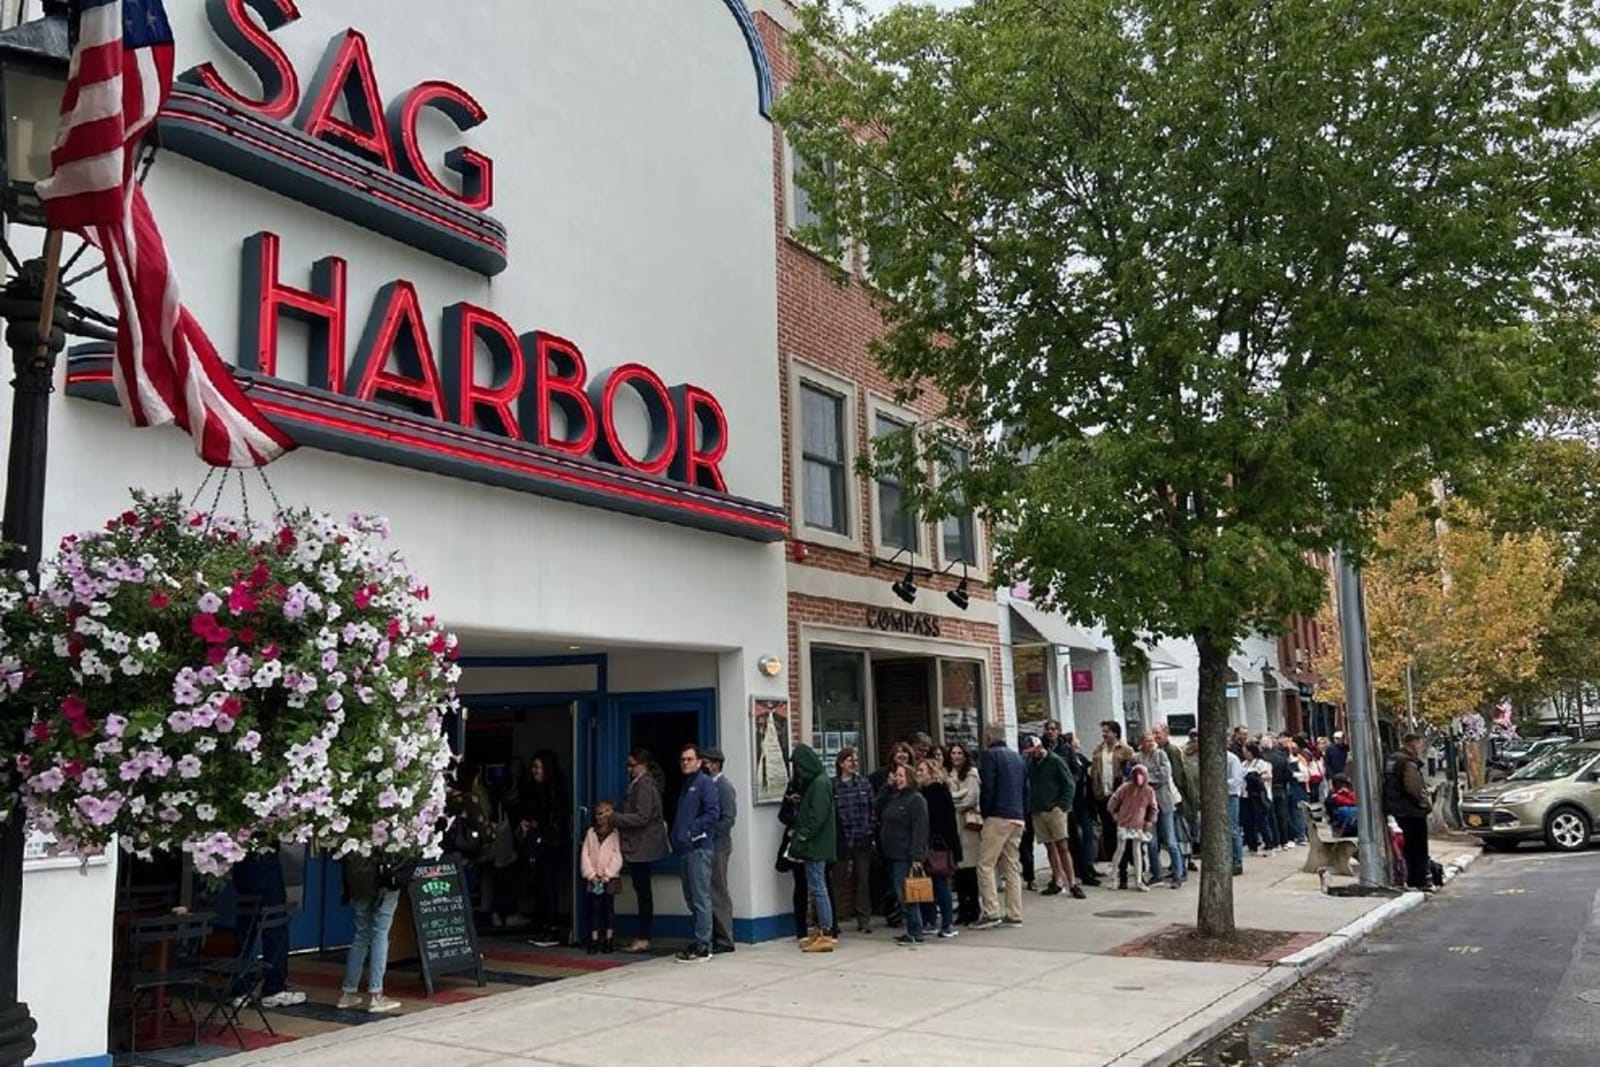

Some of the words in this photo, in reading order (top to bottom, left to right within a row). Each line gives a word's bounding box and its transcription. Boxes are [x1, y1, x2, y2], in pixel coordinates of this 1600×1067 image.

[178, 0, 494, 211] SAG
[241, 230, 729, 495] HARBOR
[866, 607, 940, 637] COMPASS
